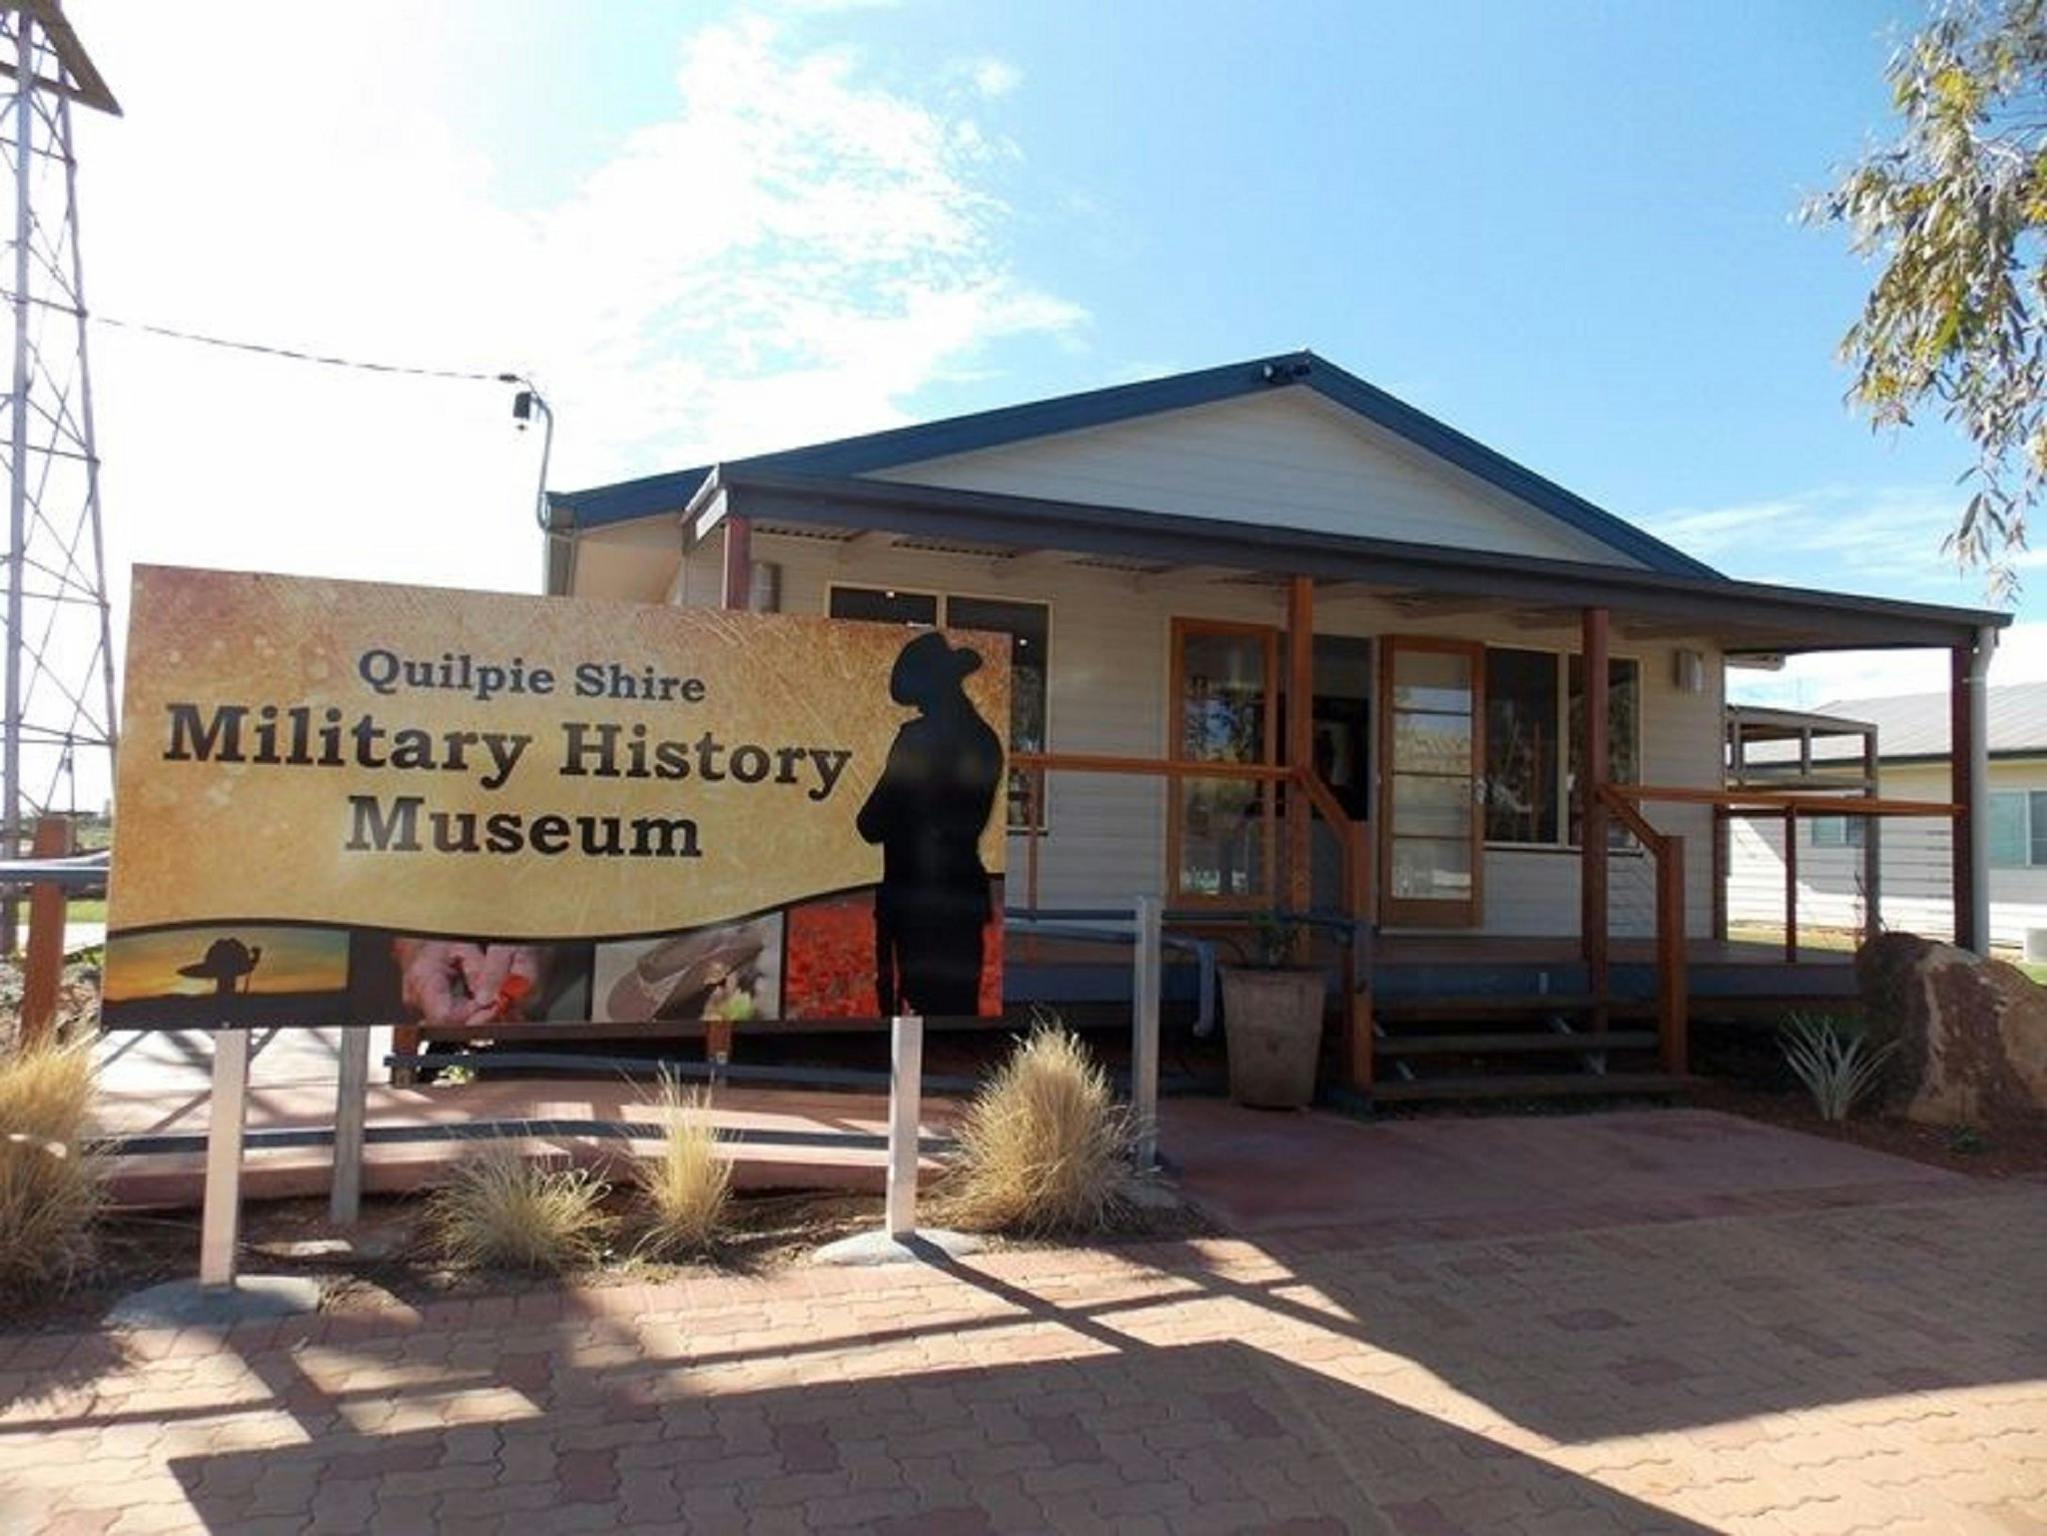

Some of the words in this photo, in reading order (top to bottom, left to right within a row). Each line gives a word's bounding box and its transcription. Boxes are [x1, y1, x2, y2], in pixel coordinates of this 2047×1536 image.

[358, 649, 556, 702] Quilpie
[574, 661, 706, 704] Shire
[162, 703, 533, 791] Military
[558, 722, 853, 802] History
[346, 794, 704, 859] Museum
